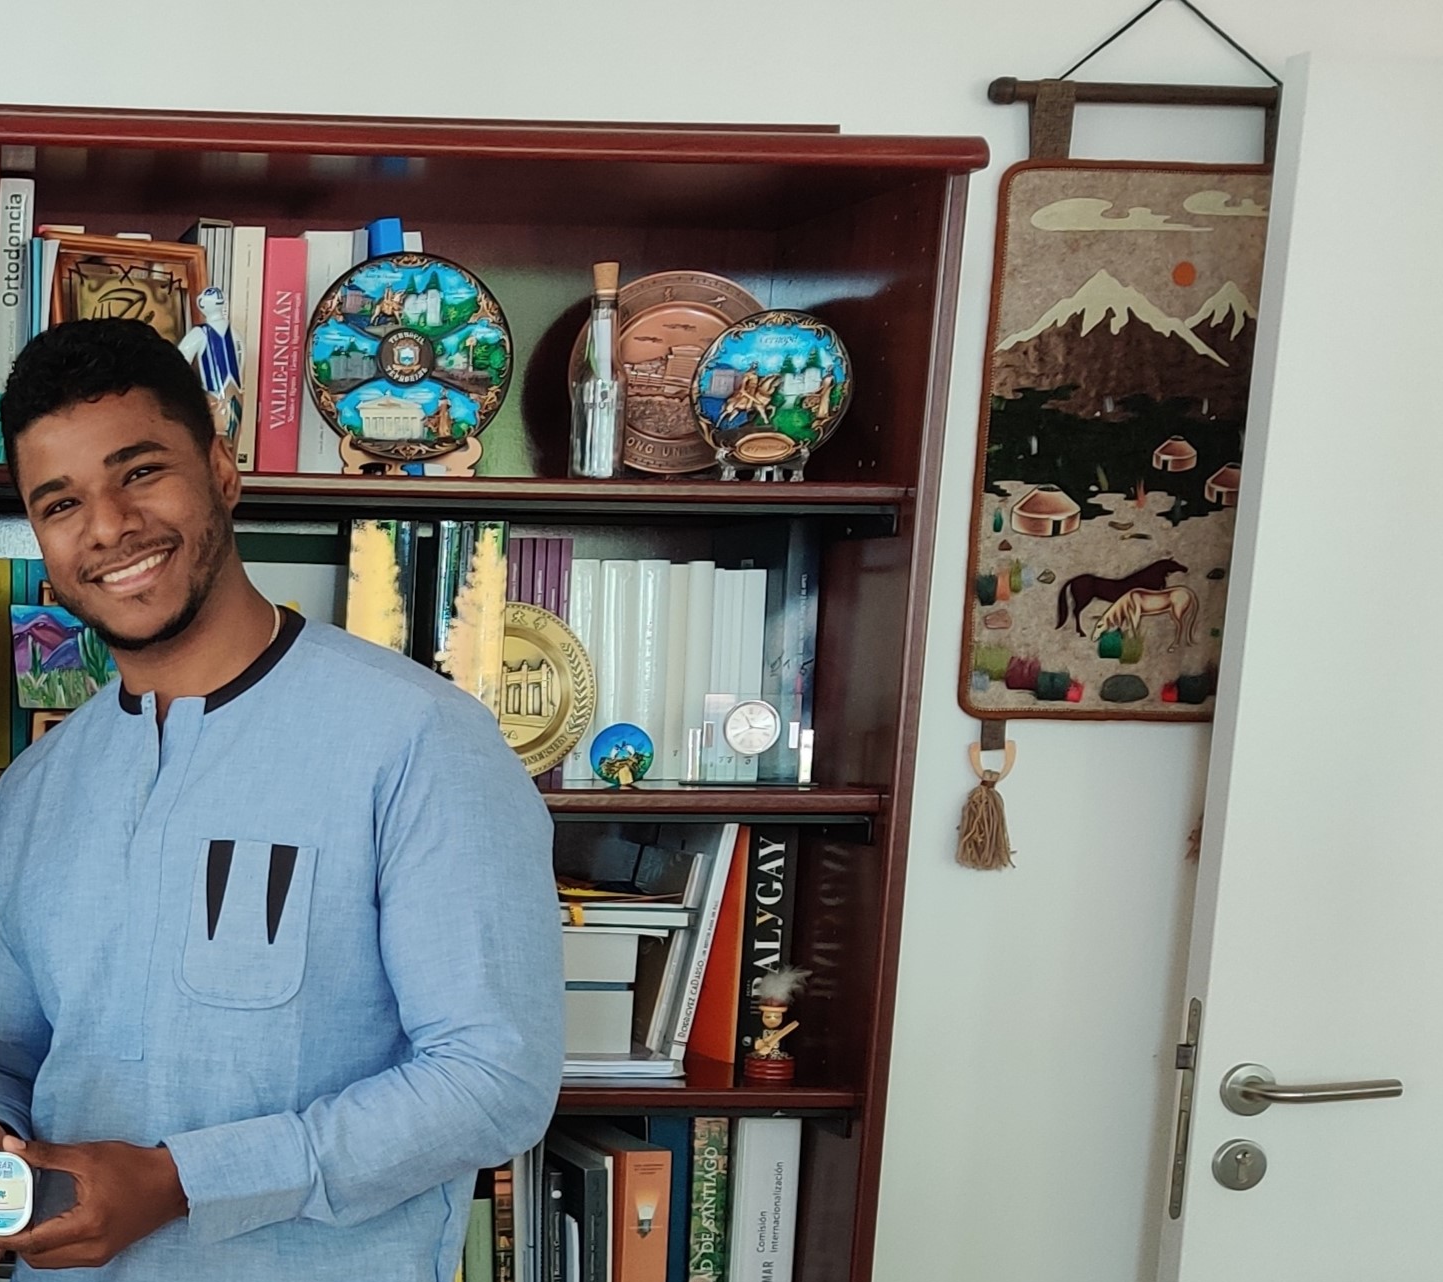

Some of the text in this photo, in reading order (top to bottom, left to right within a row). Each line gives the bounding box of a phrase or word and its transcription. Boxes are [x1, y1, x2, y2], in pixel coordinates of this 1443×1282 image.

[1, 193, 22, 307] Ortodoncia
[269, 290, 293, 430] VALLE-INCLÁN
[701, 1147, 718, 1227] SANTIAGO
[770, 1161, 784, 1254] Internacionalización
[700, 1231, 715, 1254] DE
[756, 1211, 767, 1254] Comisión
